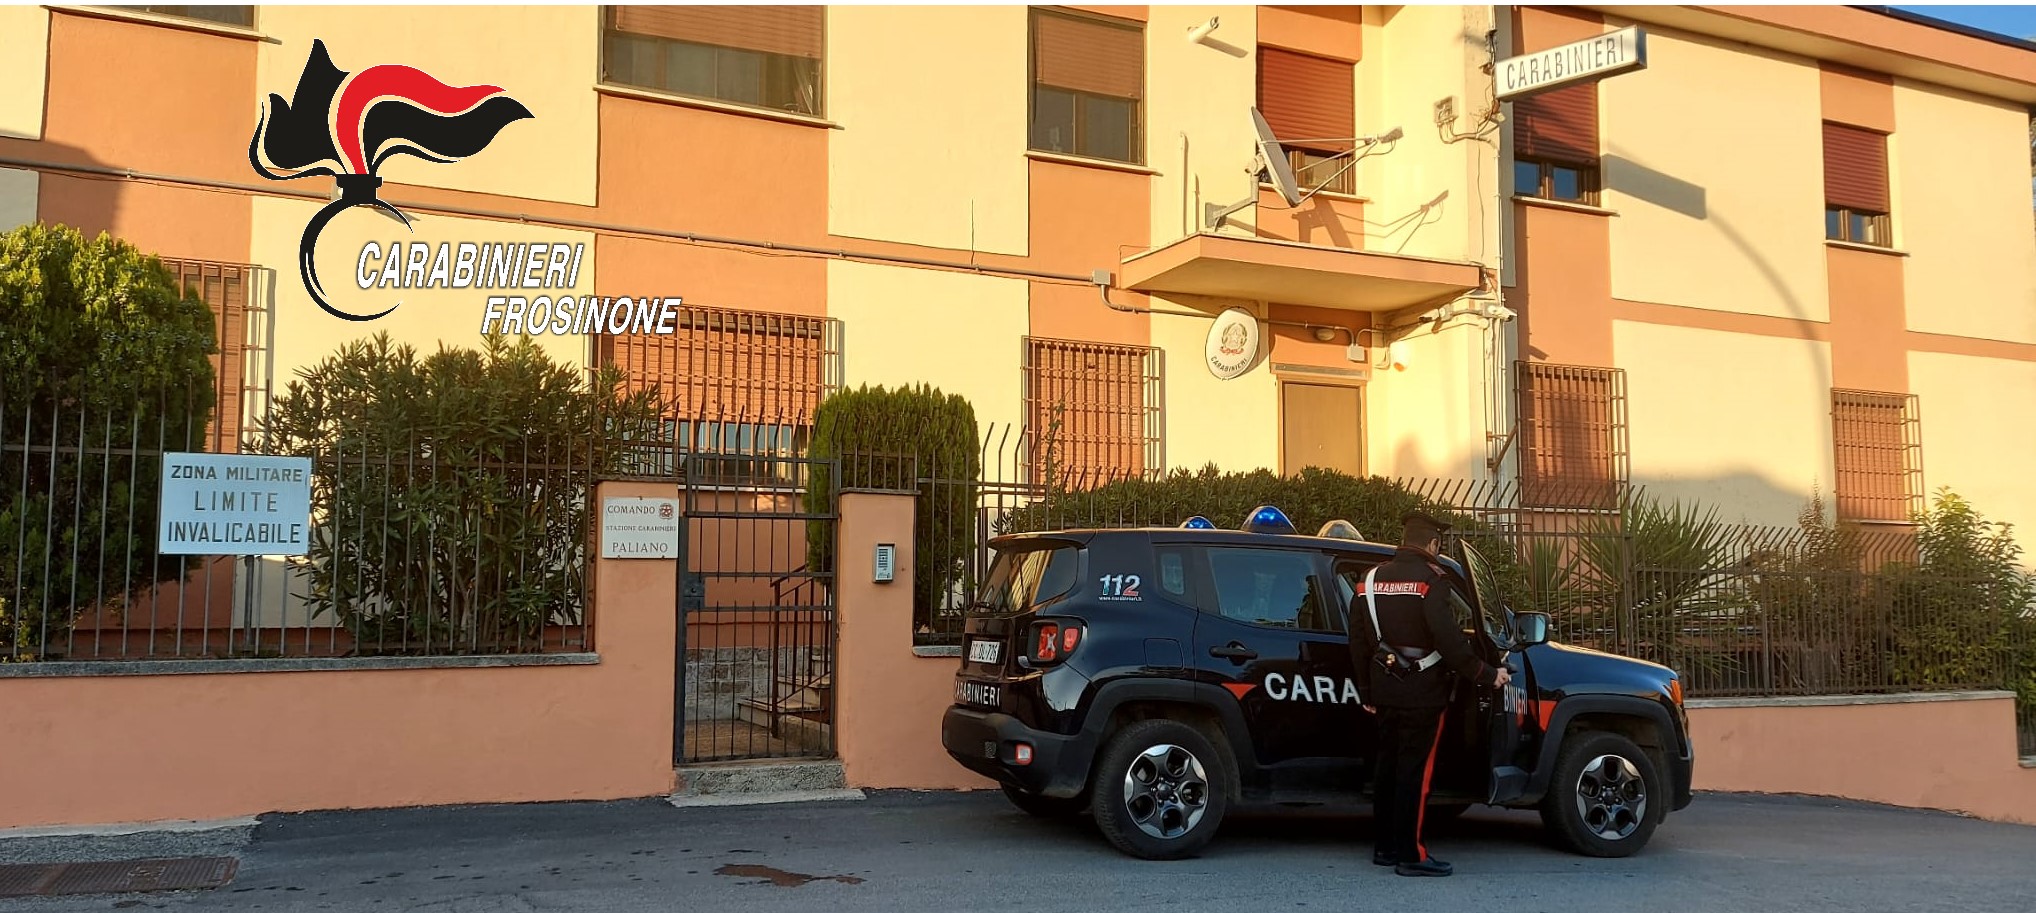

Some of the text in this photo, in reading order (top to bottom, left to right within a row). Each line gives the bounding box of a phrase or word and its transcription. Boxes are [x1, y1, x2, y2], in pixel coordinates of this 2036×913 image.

[1507, 34, 1624, 89] CARABINIERI
[1211, 356, 1247, 372] CARABINIERI
[171, 465, 303, 482] ZONA MILITARE
[194, 490, 278, 512] LIMITE
[607, 505, 655, 514] COMANDO
[168, 521, 301, 543] INVALICABILE
[612, 542, 668, 553] PALIANO
[1100, 574, 1140, 596] 112
[1374, 582, 1417, 592] ARABINIERI
